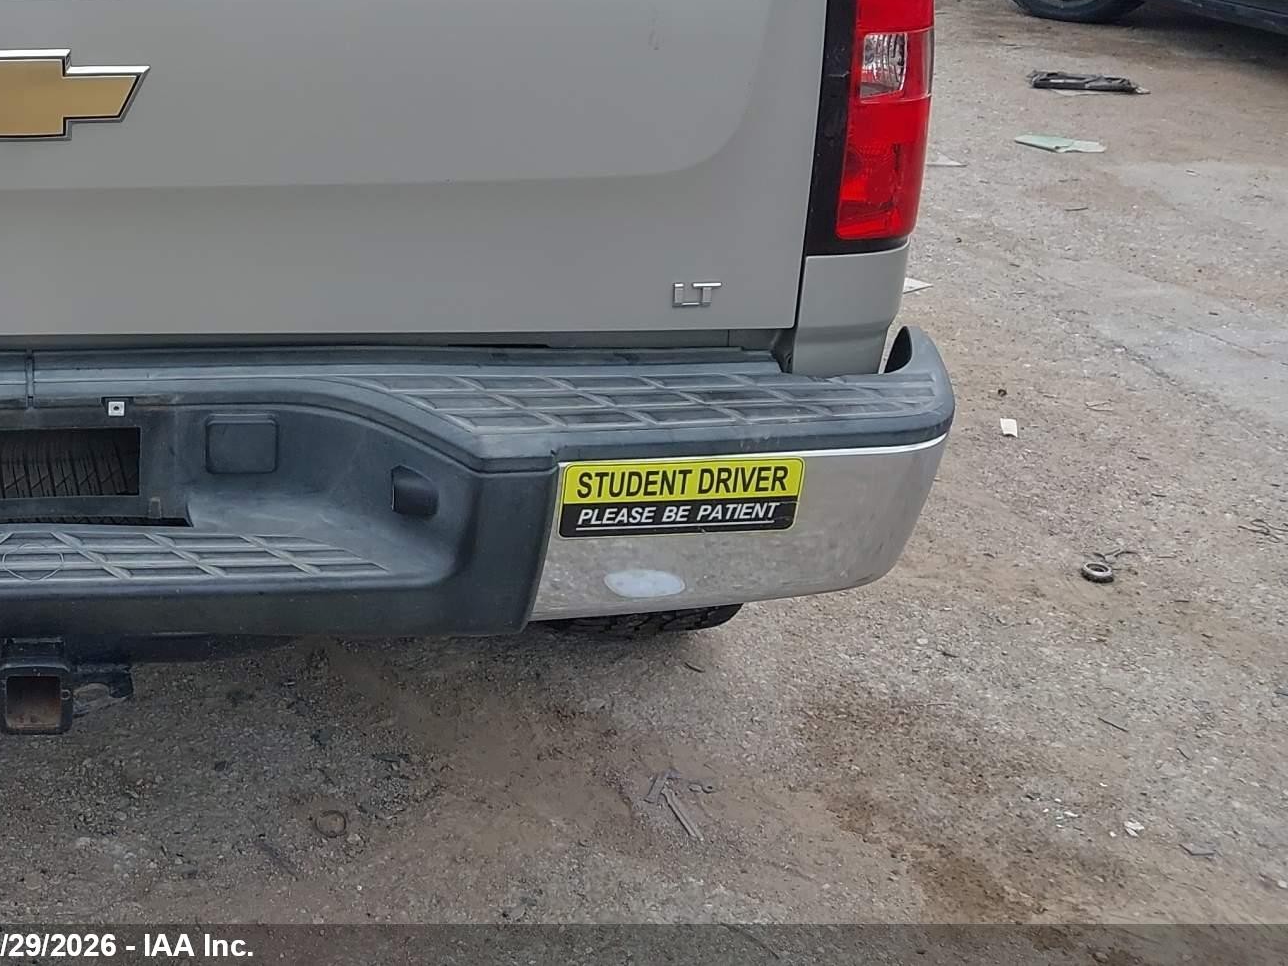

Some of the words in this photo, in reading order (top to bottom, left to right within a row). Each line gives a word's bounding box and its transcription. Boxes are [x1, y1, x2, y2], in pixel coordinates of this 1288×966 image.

[673, 281, 722, 307] LT
[576, 468, 693, 499] STUDENT
[697, 465, 789, 495] DRIVER
[577, 506, 657, 525] PLEASE
[662, 505, 691, 523] BE
[696, 502, 780, 521] PATIENT
